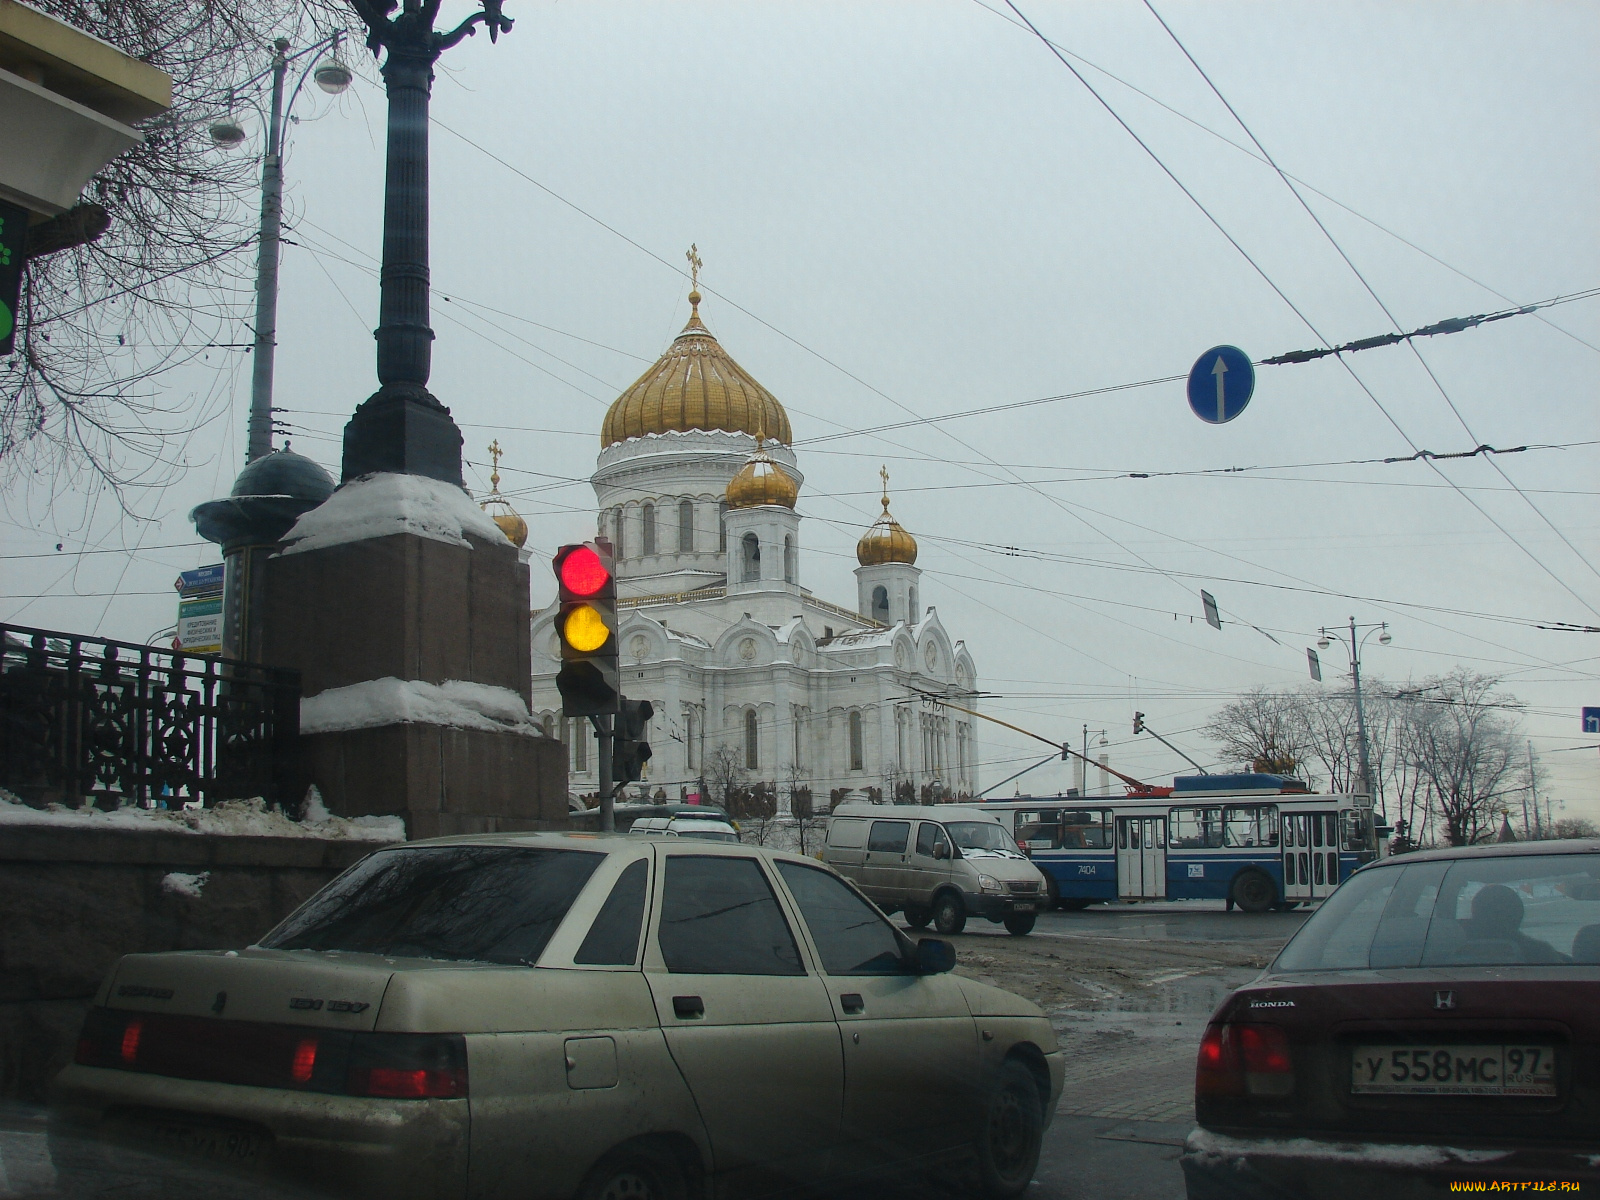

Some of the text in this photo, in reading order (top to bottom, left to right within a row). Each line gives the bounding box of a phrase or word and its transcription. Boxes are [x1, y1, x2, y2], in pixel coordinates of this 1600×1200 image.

[1077, 865, 1096, 875] 7404
[1507, 1048, 1541, 1074] 97
[1507, 1074, 1533, 1083] RUS
